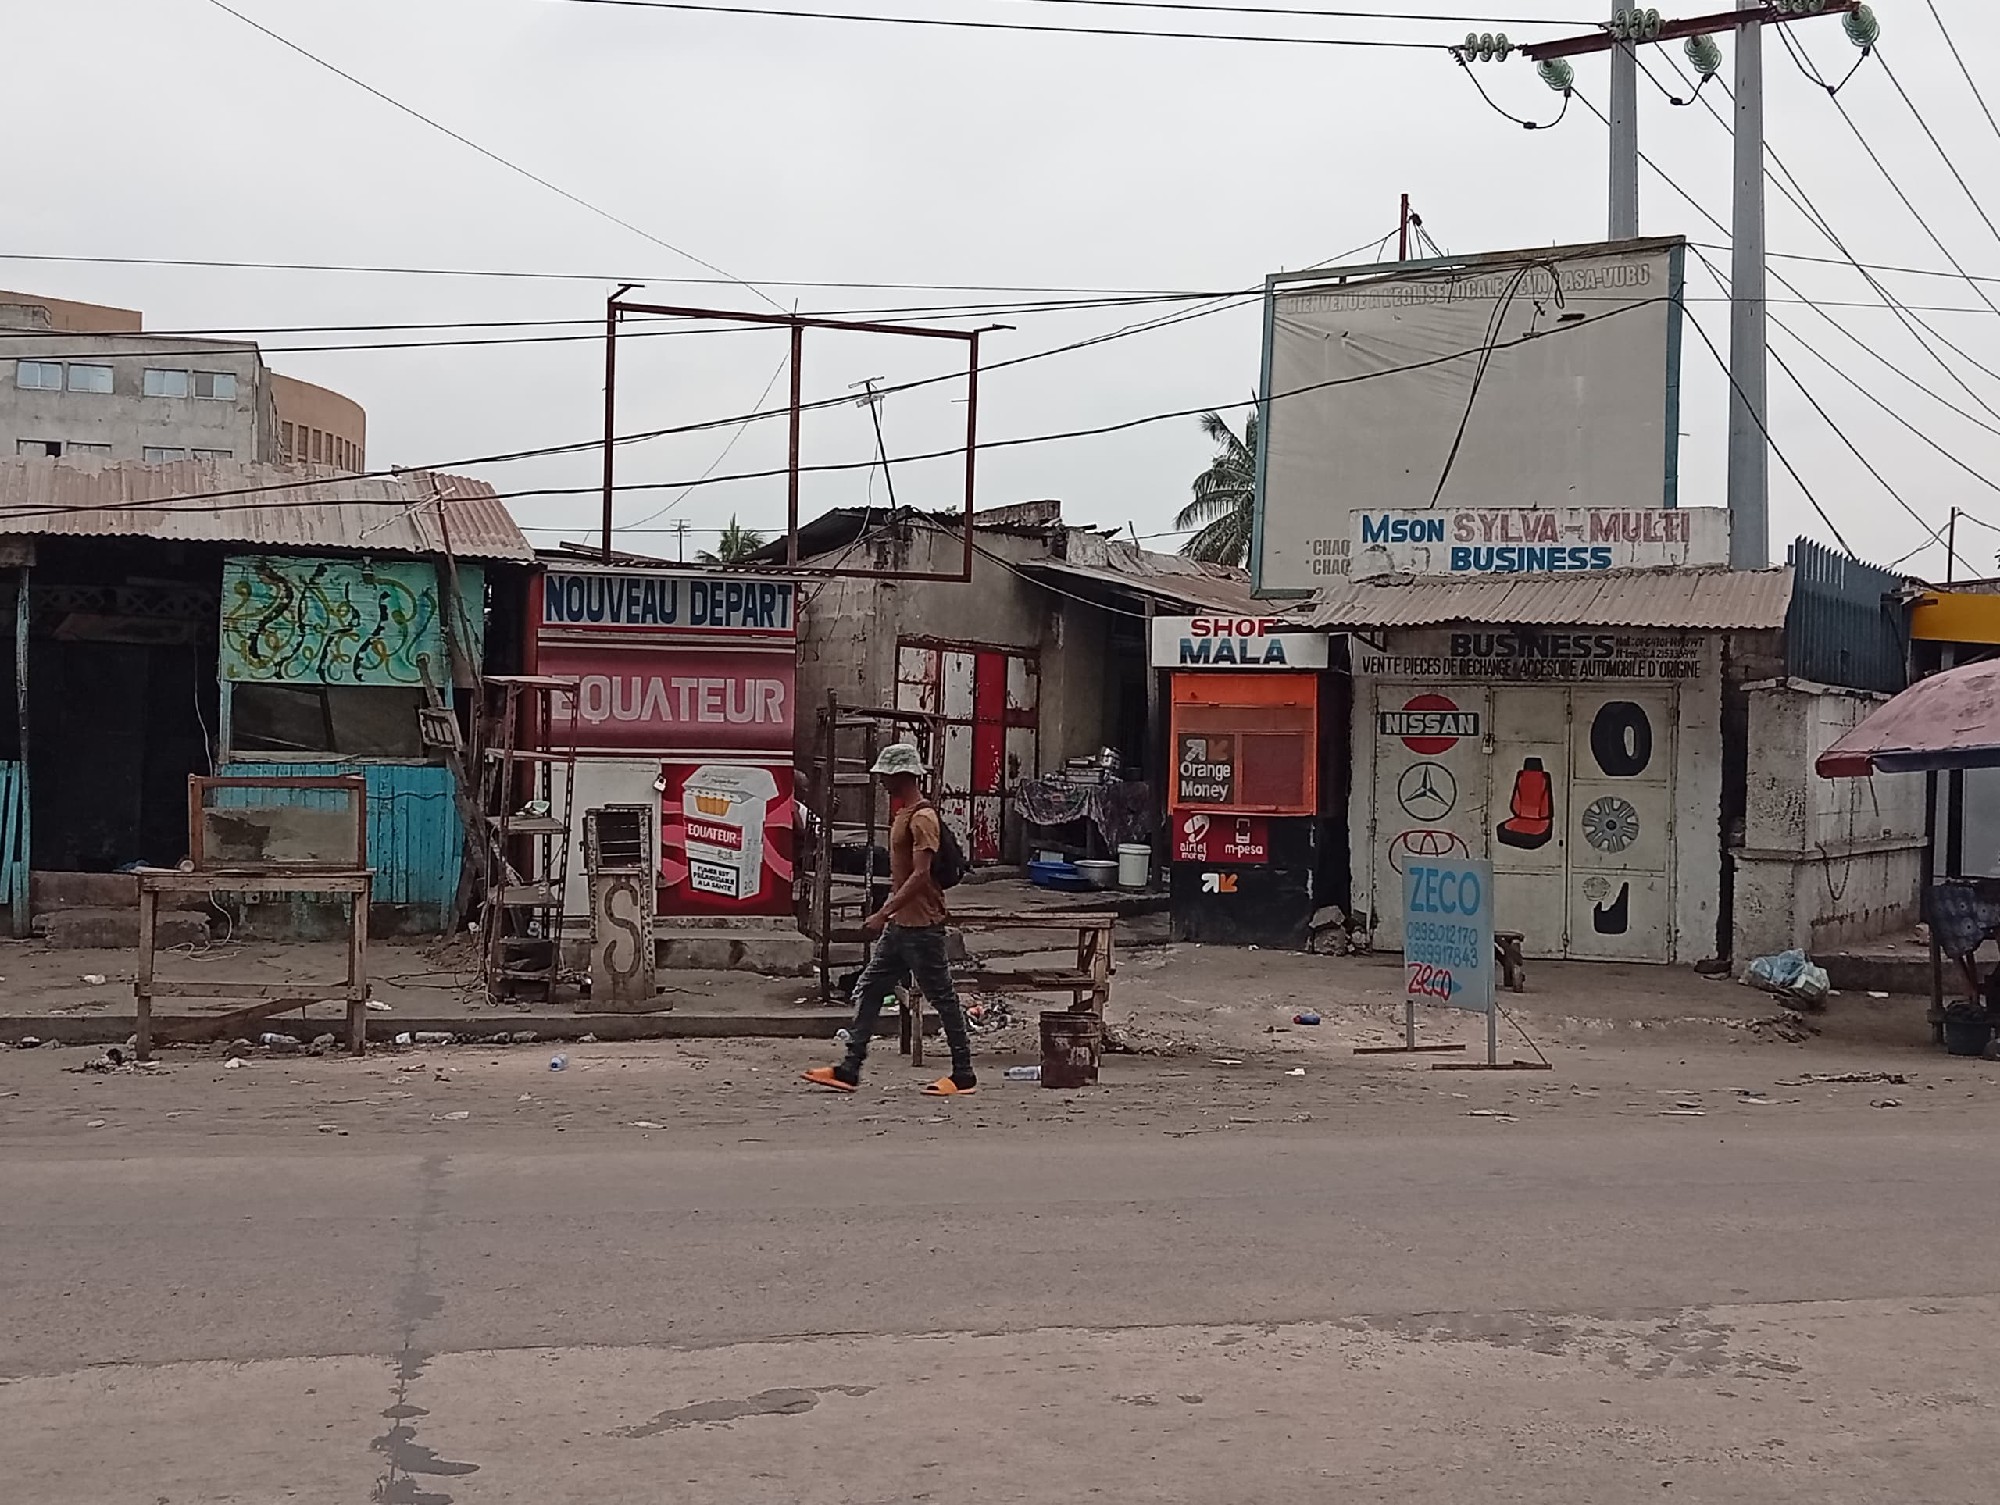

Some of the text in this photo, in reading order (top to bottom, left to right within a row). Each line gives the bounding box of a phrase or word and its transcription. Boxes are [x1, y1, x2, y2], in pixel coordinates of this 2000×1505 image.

[1451, 547, 1612, 571] BUSINESS
[546, 576, 792, 628] NOUVEAU DEPART
[1179, 638, 1287, 664] MALA
[1450, 632, 1615, 659] BUSINESS
[1362, 656, 1400, 674] VENTE
[1403, 657, 1441, 676] PIECES
[1443, 657, 1457, 676] DE
[1580, 660, 1645, 678] AUTOMOBILE
[1648, 660, 1700, 678] D'ORIGINE
[552, 674, 785, 724] EQUATEUR
[1385, 713, 1474, 734] NISSAN
[1180, 761, 1231, 780] Orange
[1181, 781, 1229, 802] Money
[688, 823, 737, 844] EQUATEUR
[1179, 842, 1206, 853] airtel
[1225, 844, 1263, 858] m-pesa
[1409, 867, 1480, 915] ZECO
[1406, 921, 1478, 946] 0898012170
